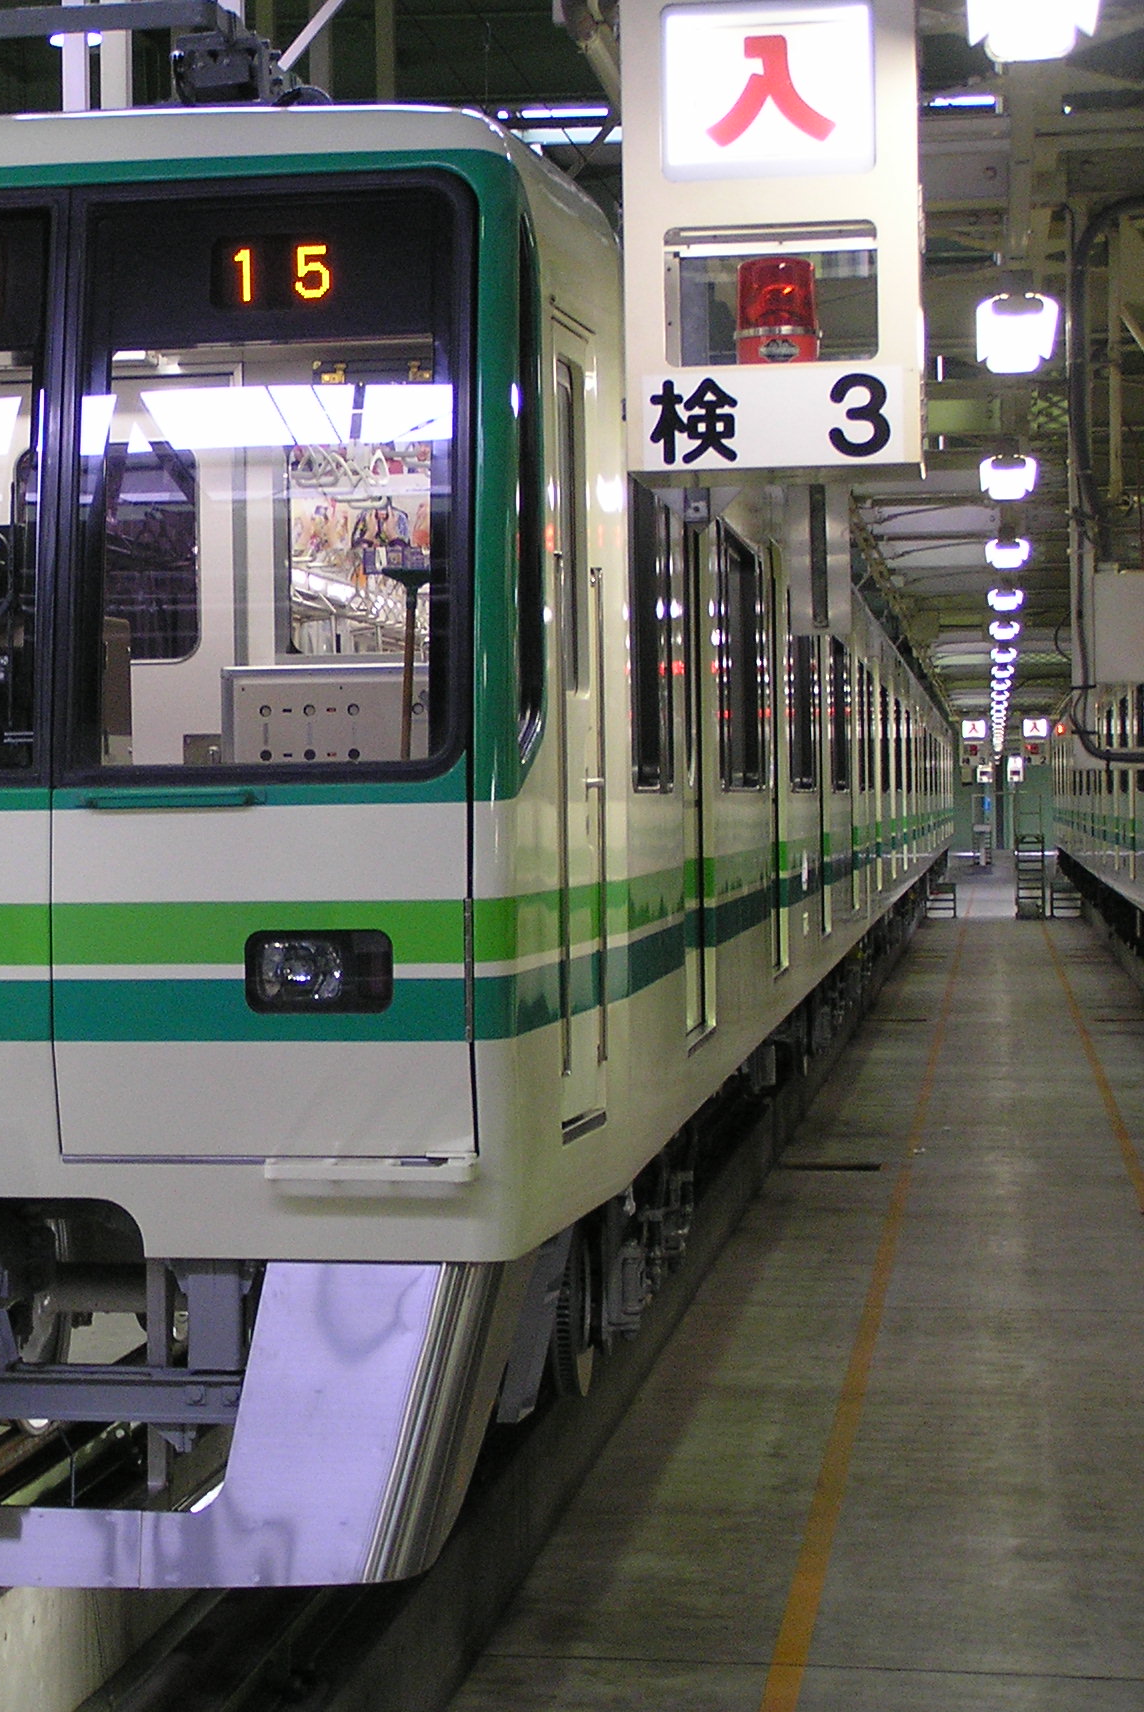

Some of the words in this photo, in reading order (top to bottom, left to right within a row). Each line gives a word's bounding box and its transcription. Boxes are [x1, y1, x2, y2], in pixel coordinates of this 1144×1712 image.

[705, 34, 836, 147] 入
[649, 377, 739, 466] 検
[827, 372, 891, 458] 3
